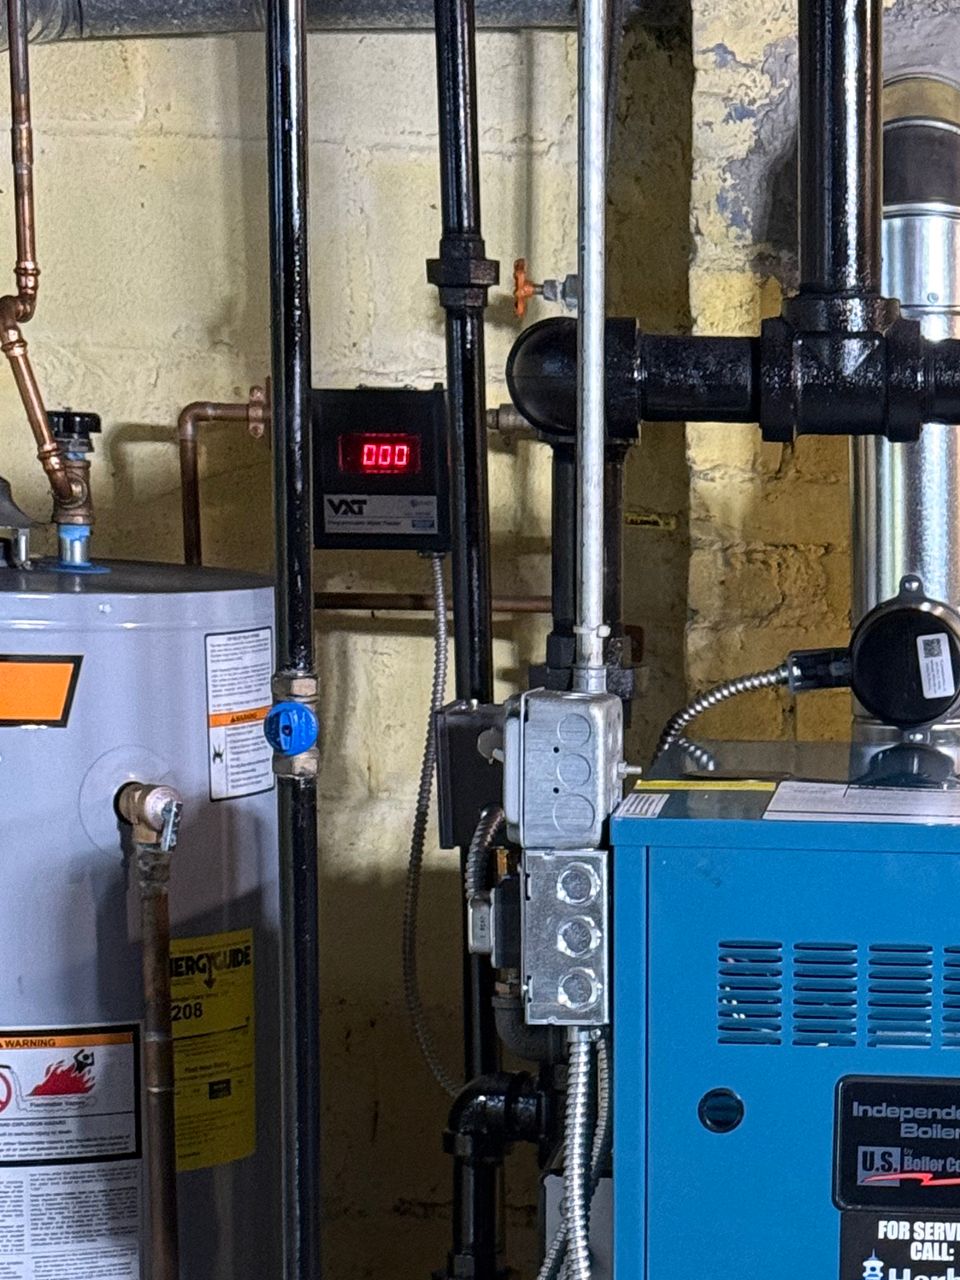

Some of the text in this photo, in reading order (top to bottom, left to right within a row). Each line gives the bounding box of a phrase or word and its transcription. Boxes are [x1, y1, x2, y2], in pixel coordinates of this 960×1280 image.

[363, 444, 408, 465] 000
[5, 1039, 55, 1047] WARNING
[862, 1151, 898, 1172] U.S.
[904, 1156, 944, 1172] Boiler
[878, 1221, 910, 1240] FOR
[910, 1242, 955, 1261] CALL:
